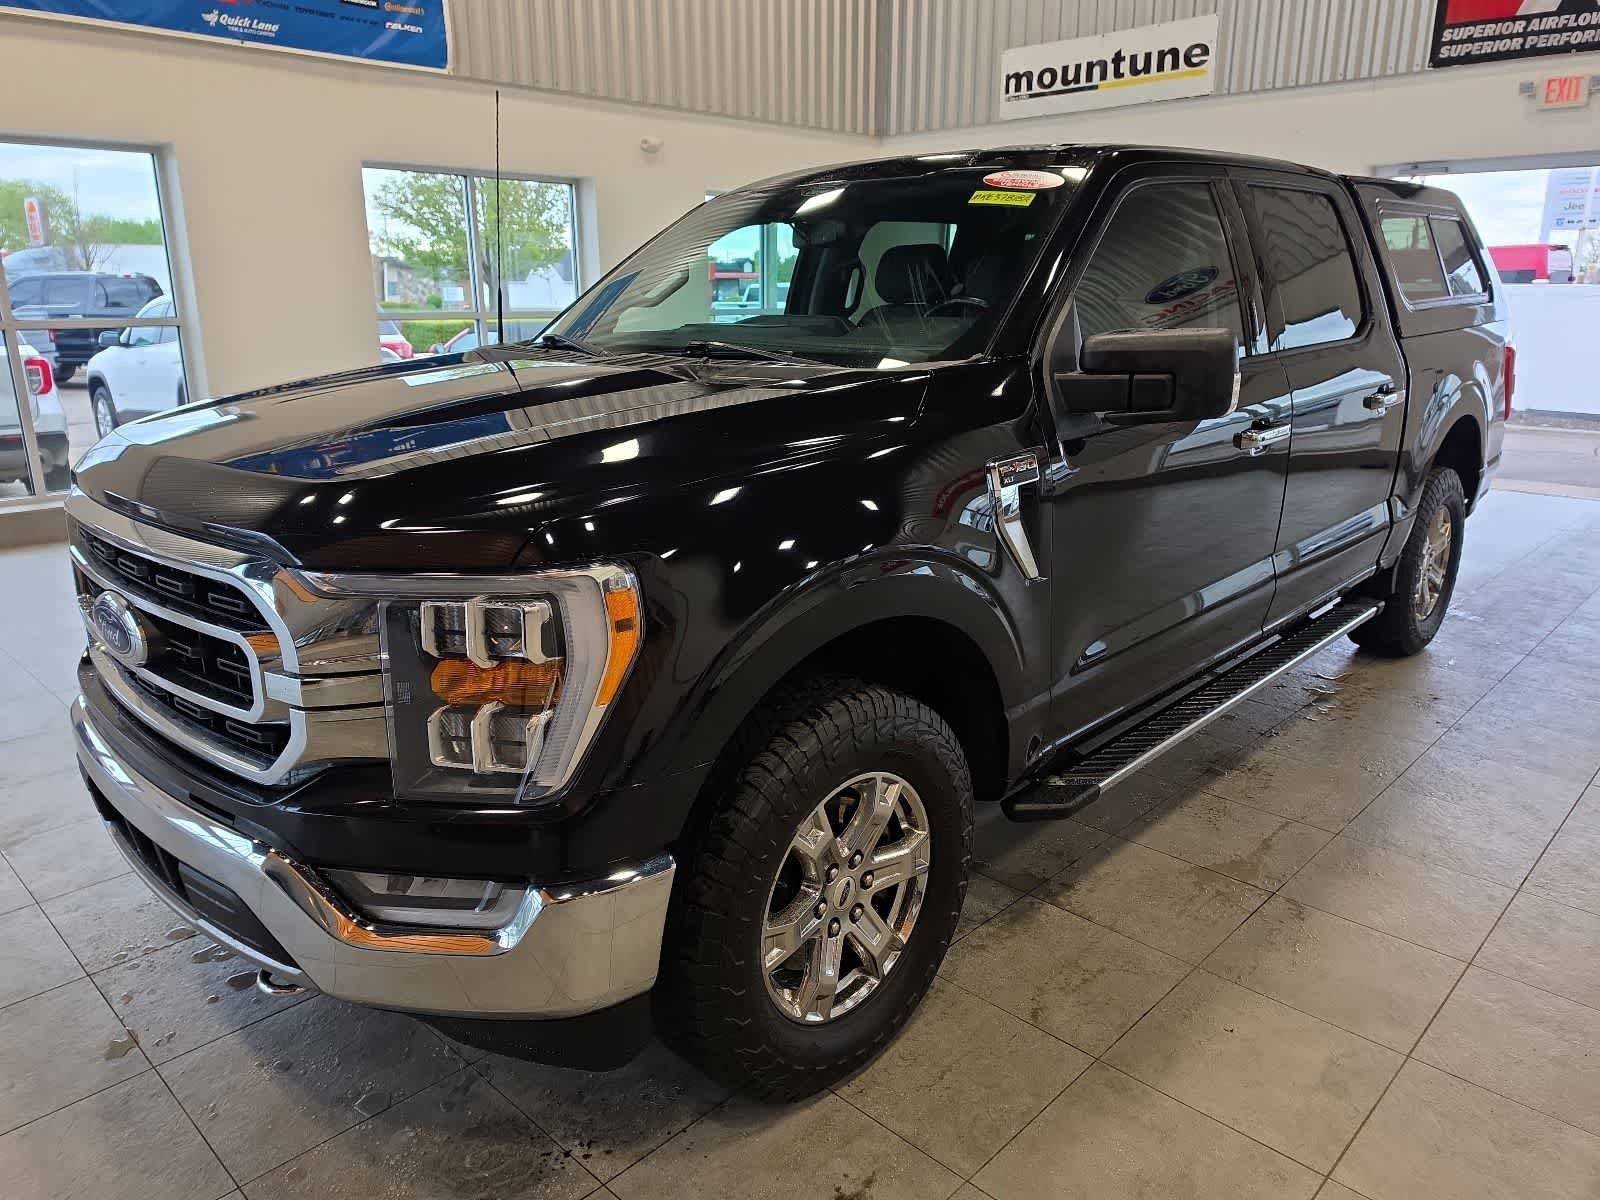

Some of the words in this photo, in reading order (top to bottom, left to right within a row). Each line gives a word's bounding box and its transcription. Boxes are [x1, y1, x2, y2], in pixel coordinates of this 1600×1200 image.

[219, 14, 250, 26] Quick
[251, 19, 280, 32] Lane
[1442, 21, 1526, 42] SUPERIOR
[1439, 37, 1525, 59] SUPERIOR
[1004, 42, 1210, 94] mountune
[1544, 76, 1584, 104] EXIT
